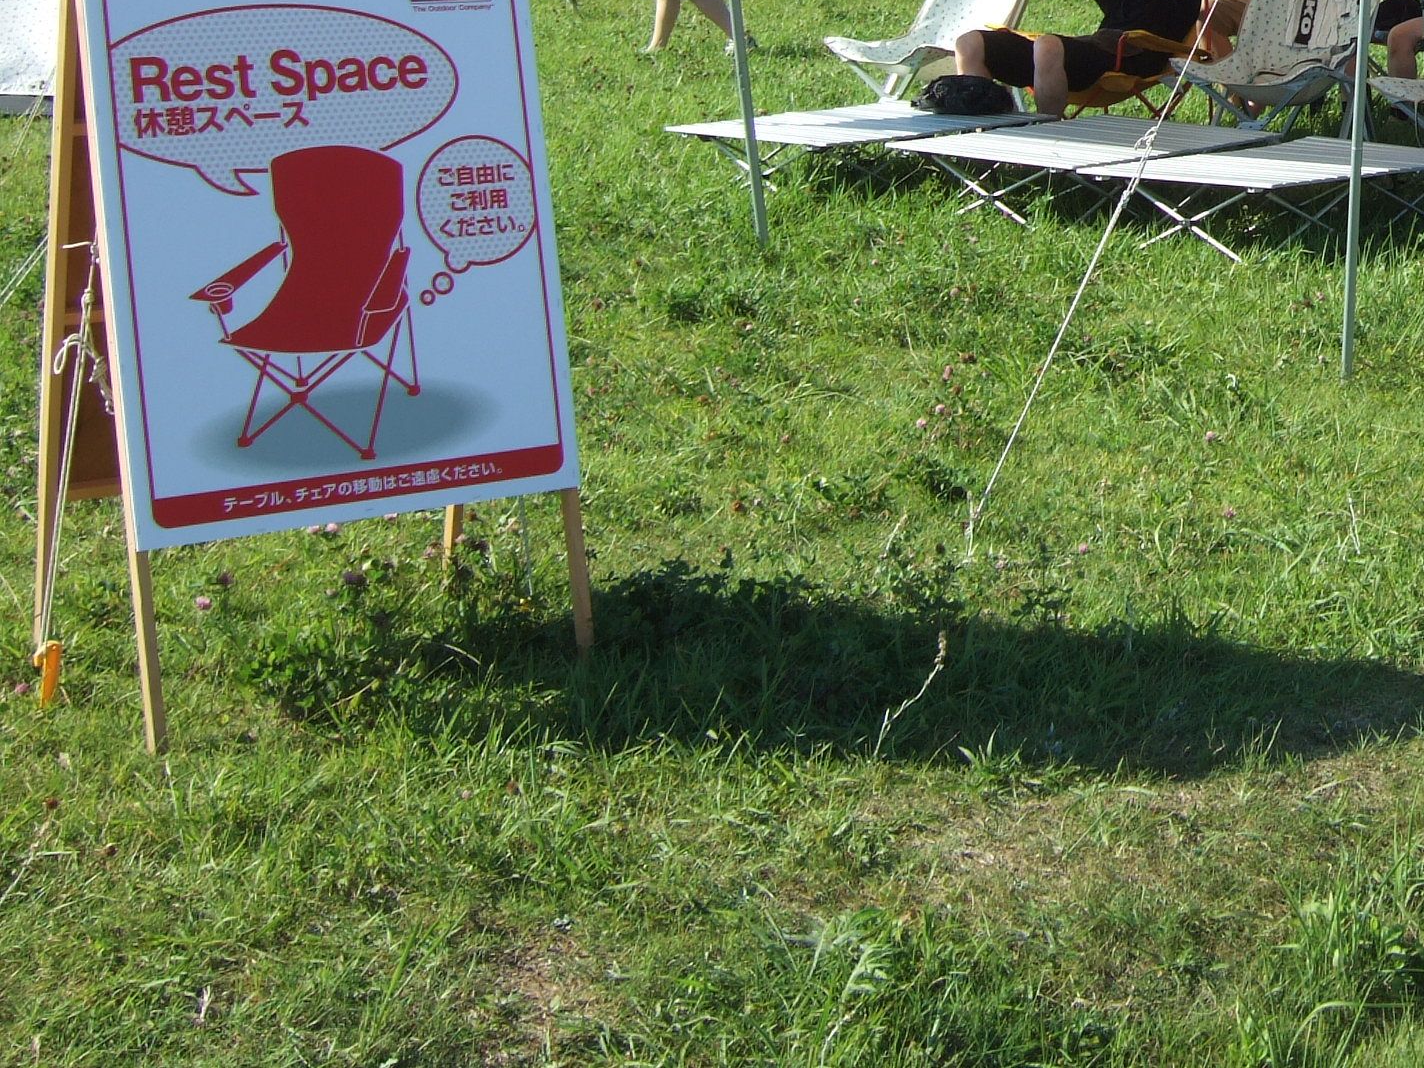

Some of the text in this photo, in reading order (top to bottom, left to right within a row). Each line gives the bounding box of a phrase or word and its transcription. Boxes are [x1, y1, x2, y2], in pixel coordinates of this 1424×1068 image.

[130, 49, 428, 103] Rest Space
[134, 101, 310, 138] 休憩スペース
[438, 163, 515, 186] ご自由に
[450, 188, 508, 211] ご利用
[440, 215, 525, 238] ください。
